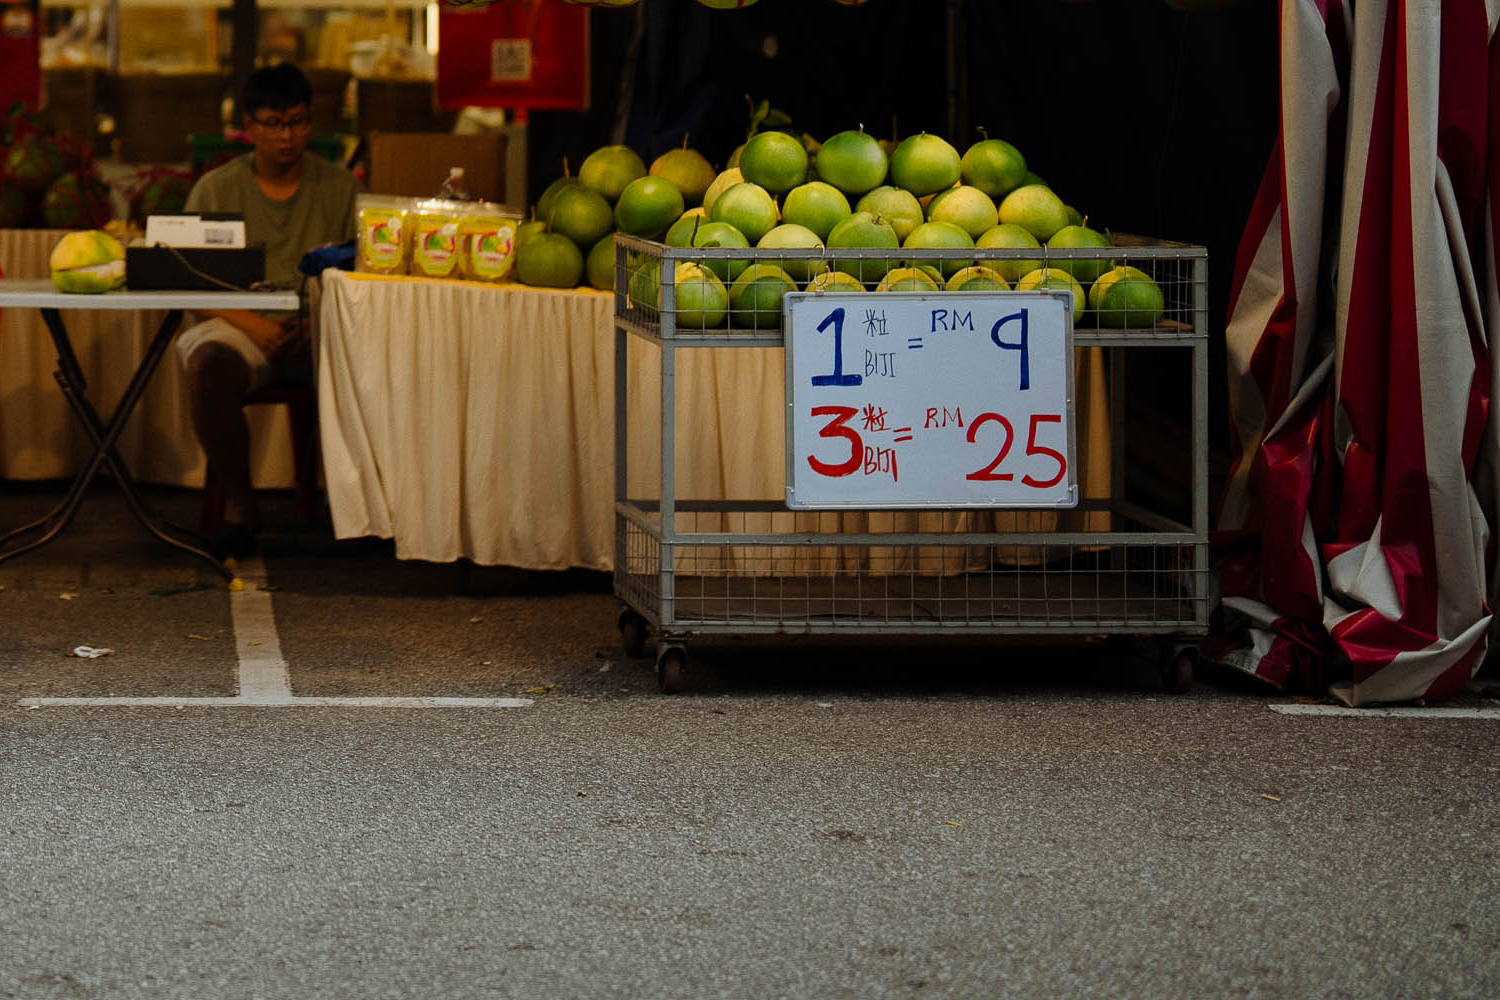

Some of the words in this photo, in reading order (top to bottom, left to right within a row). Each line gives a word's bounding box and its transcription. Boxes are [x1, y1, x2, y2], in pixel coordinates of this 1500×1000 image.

[861, 308, 890, 337] 粒
[930, 308, 975, 334] RM
[810, 307, 863, 387] 1
[990, 307, 1031, 391] 9
[864, 349, 897, 379] BIJI
[860, 403, 893, 433] 粒
[923, 407, 965, 429] RM
[806, 404, 865, 479] 3
[965, 411, 1068, 490] 25
[863, 446, 899, 483] BIJI
